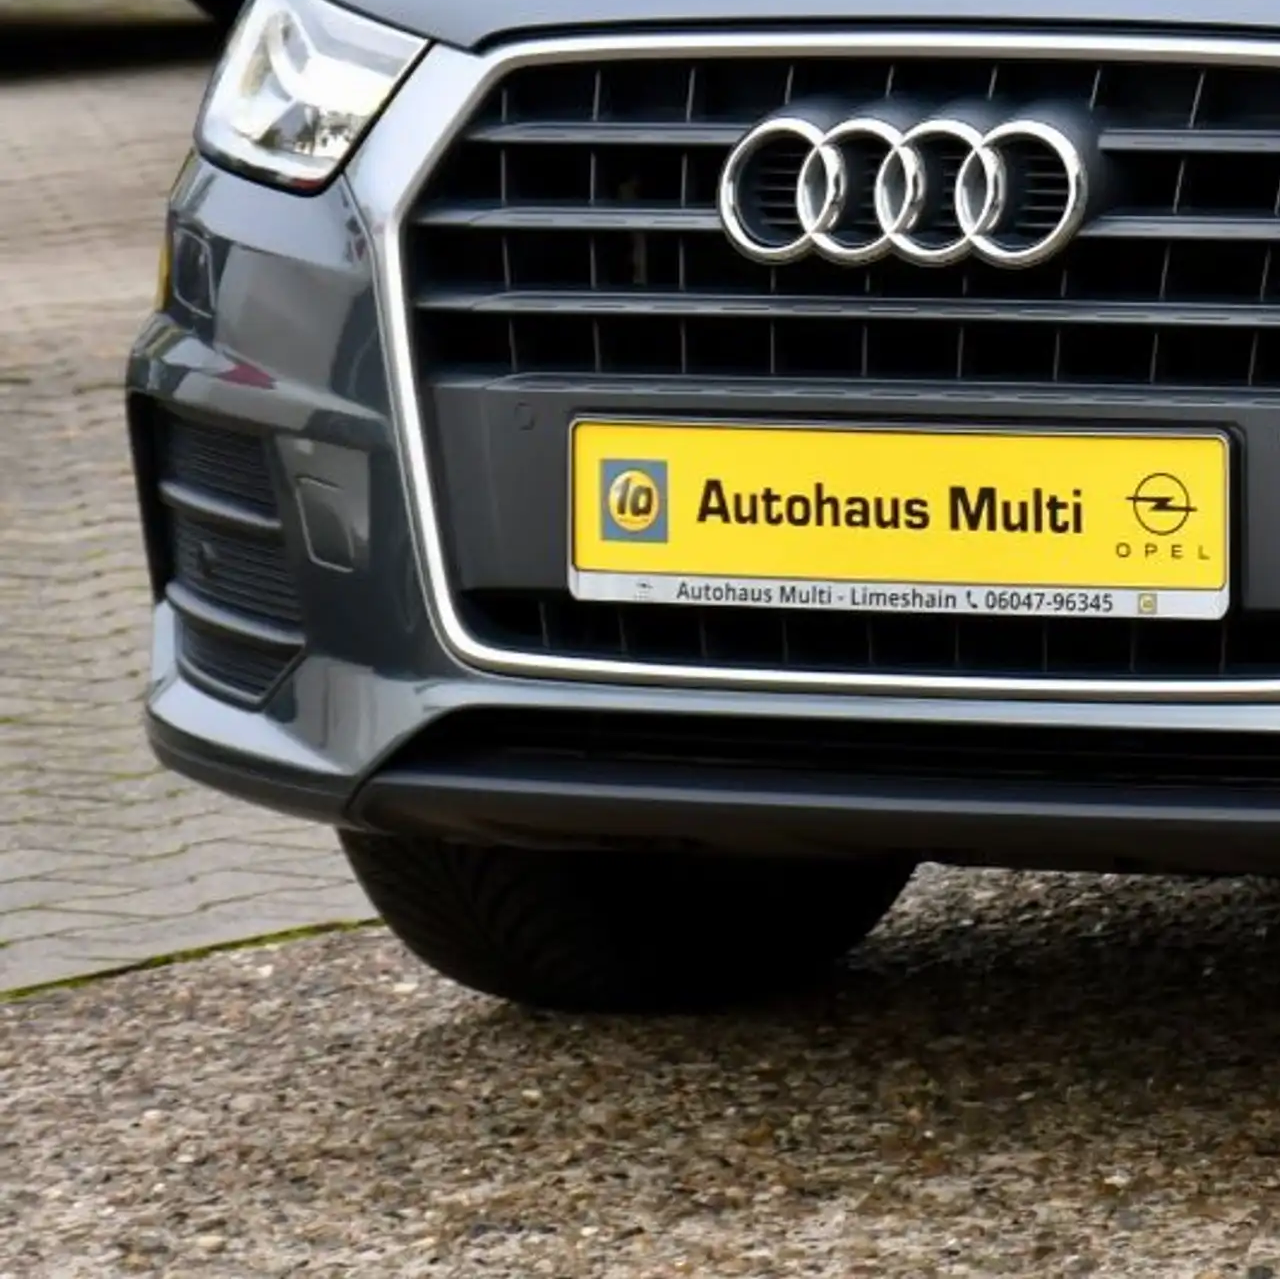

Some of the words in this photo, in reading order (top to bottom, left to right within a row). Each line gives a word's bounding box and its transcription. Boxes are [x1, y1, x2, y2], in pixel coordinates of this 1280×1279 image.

[696, 478, 930, 530] Autohaus
[949, 485, 1083, 534] Multi
[1115, 542, 1211, 560] OPEL
[676, 581, 773, 603] Autohaus
[779, 584, 832, 604] Multi
[850, 586, 957, 609] Limeshain
[985, 590, 1113, 612] 06047-96345
